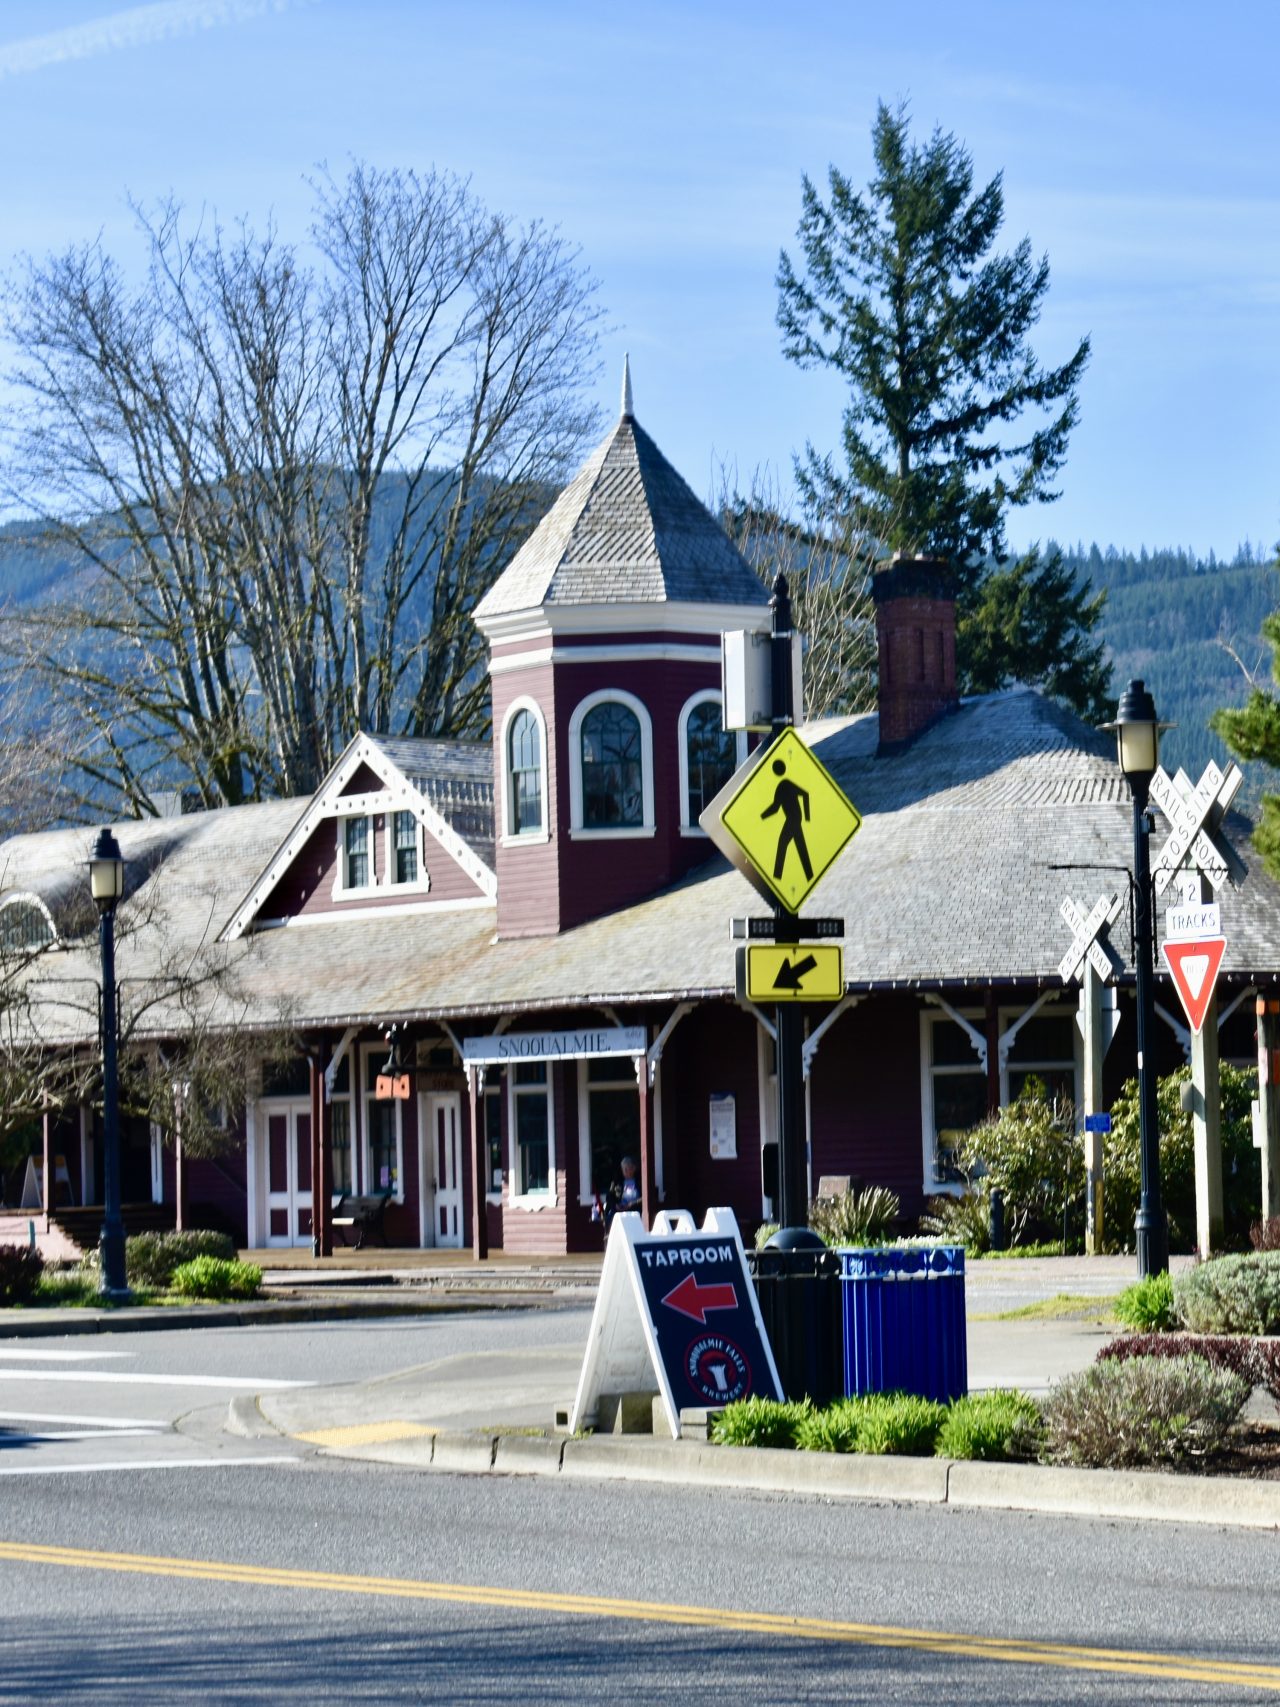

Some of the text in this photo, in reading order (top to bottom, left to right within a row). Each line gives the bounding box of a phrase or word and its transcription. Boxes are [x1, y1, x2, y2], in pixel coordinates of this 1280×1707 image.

[1154, 769, 1219, 885] CROSSING
[1188, 882, 1197, 902] 2
[1171, 912, 1216, 930] TRACKS
[641, 1245, 733, 1268] TAPROOM
[725, 1343, 746, 1373] FALLS
[702, 1381, 743, 1401] BREWERY
